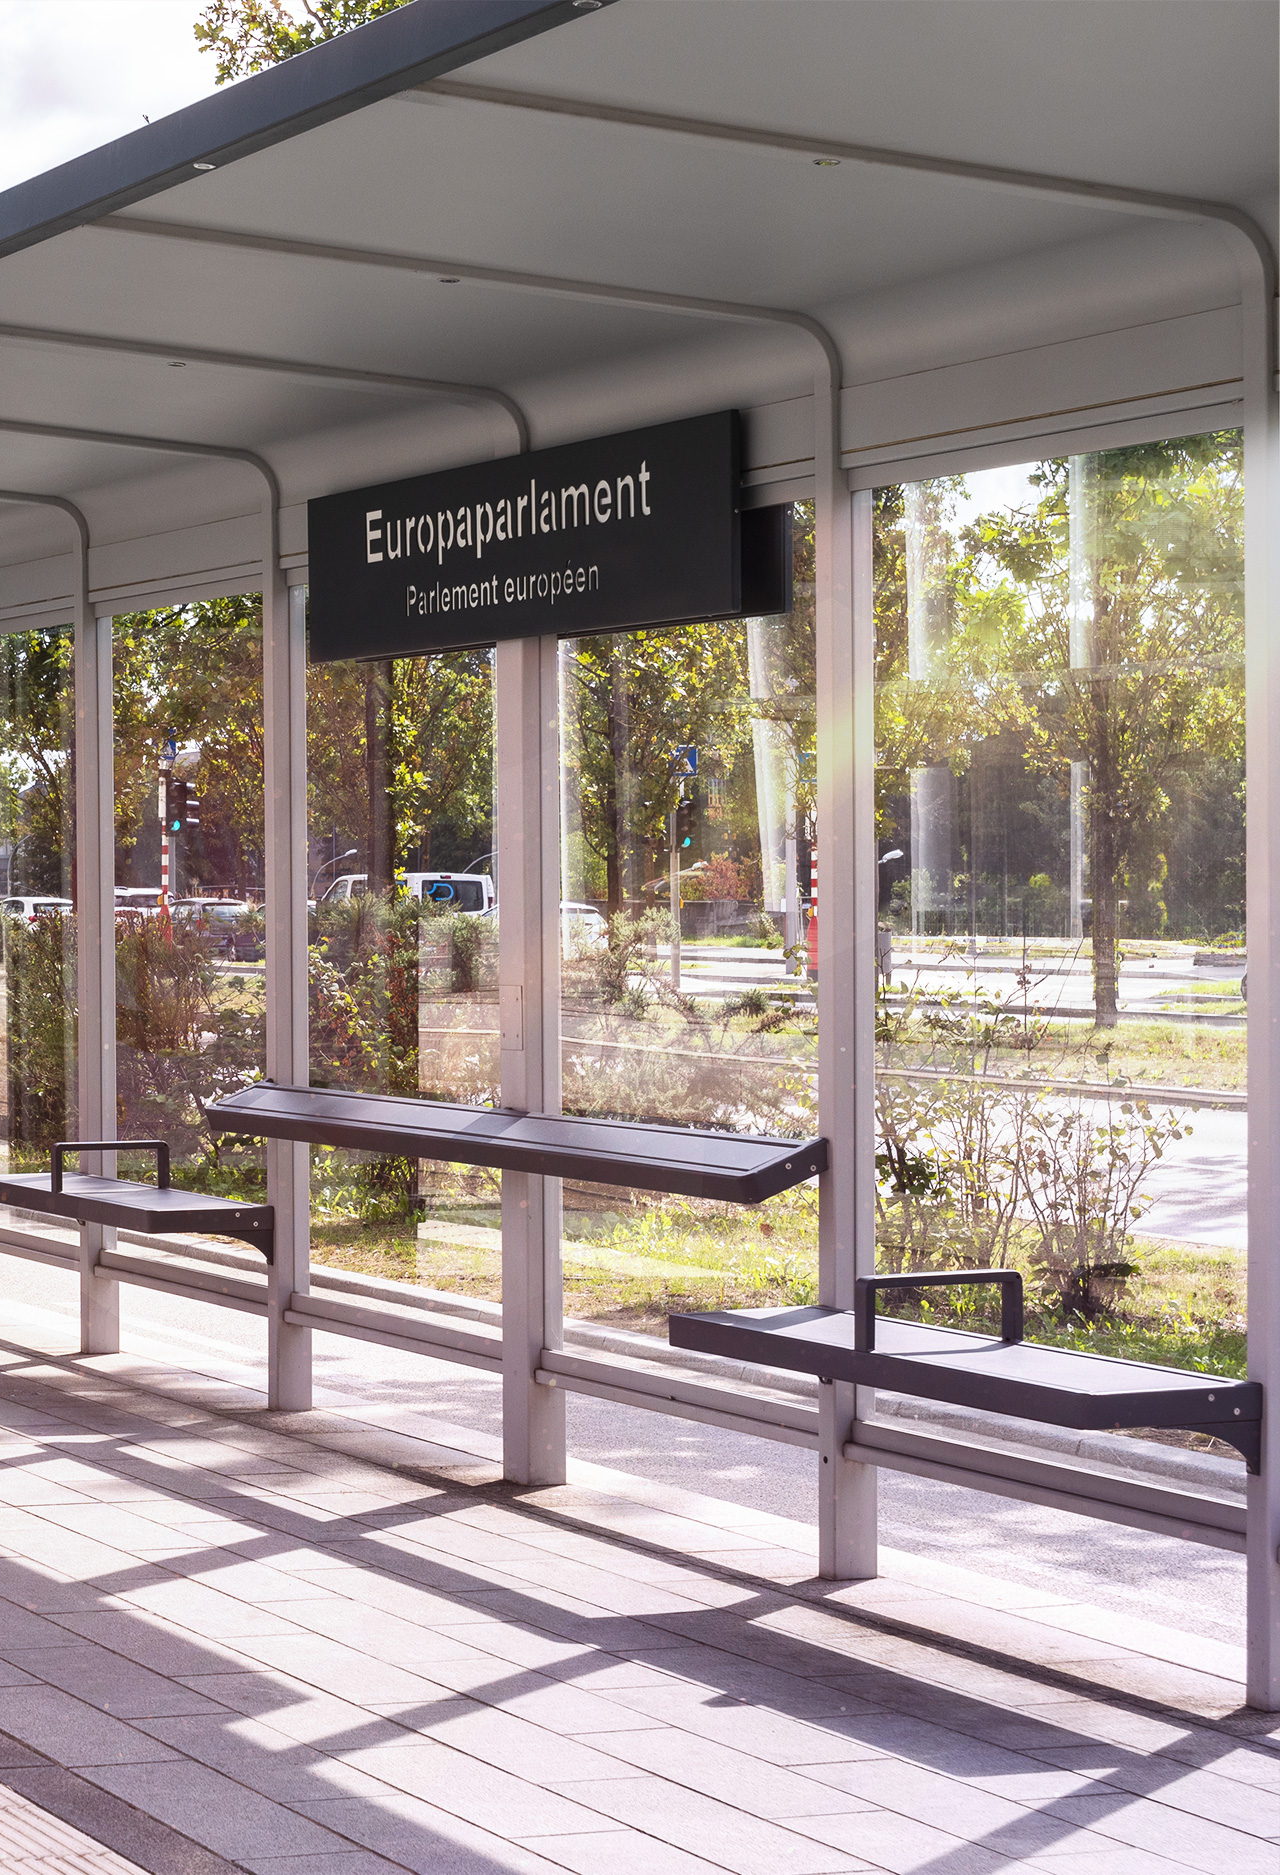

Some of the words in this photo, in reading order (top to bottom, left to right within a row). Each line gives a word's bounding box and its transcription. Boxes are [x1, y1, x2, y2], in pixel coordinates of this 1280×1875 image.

[365, 460, 651, 565] Europaparlament
[405, 574, 498, 617] Parlement
[503, 560, 599, 604] européen
